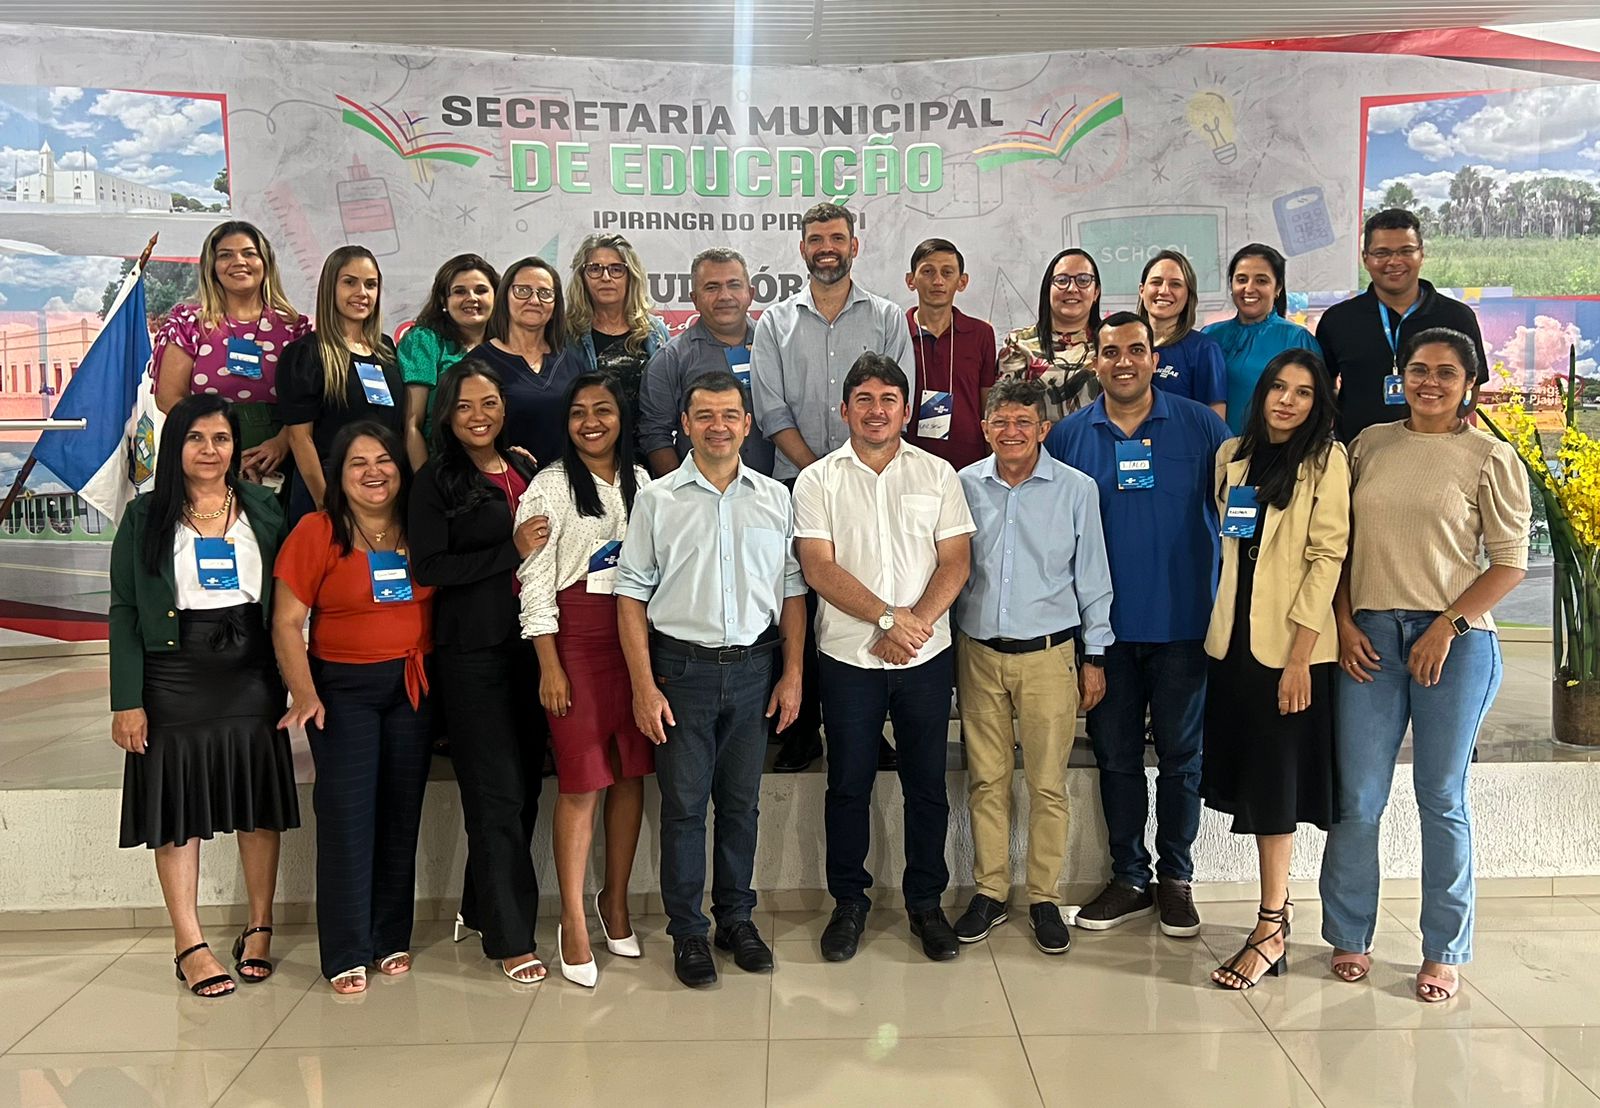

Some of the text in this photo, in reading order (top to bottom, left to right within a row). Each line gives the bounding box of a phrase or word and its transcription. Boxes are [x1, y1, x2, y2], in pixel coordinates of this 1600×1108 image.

[441, 95, 1004, 136] SECRETARIA MUNICIPAL
[510, 133, 944, 206] DE EDUCAÇÃO
[593, 211, 715, 231] IPIRANGA
[721, 213, 755, 231] DO
